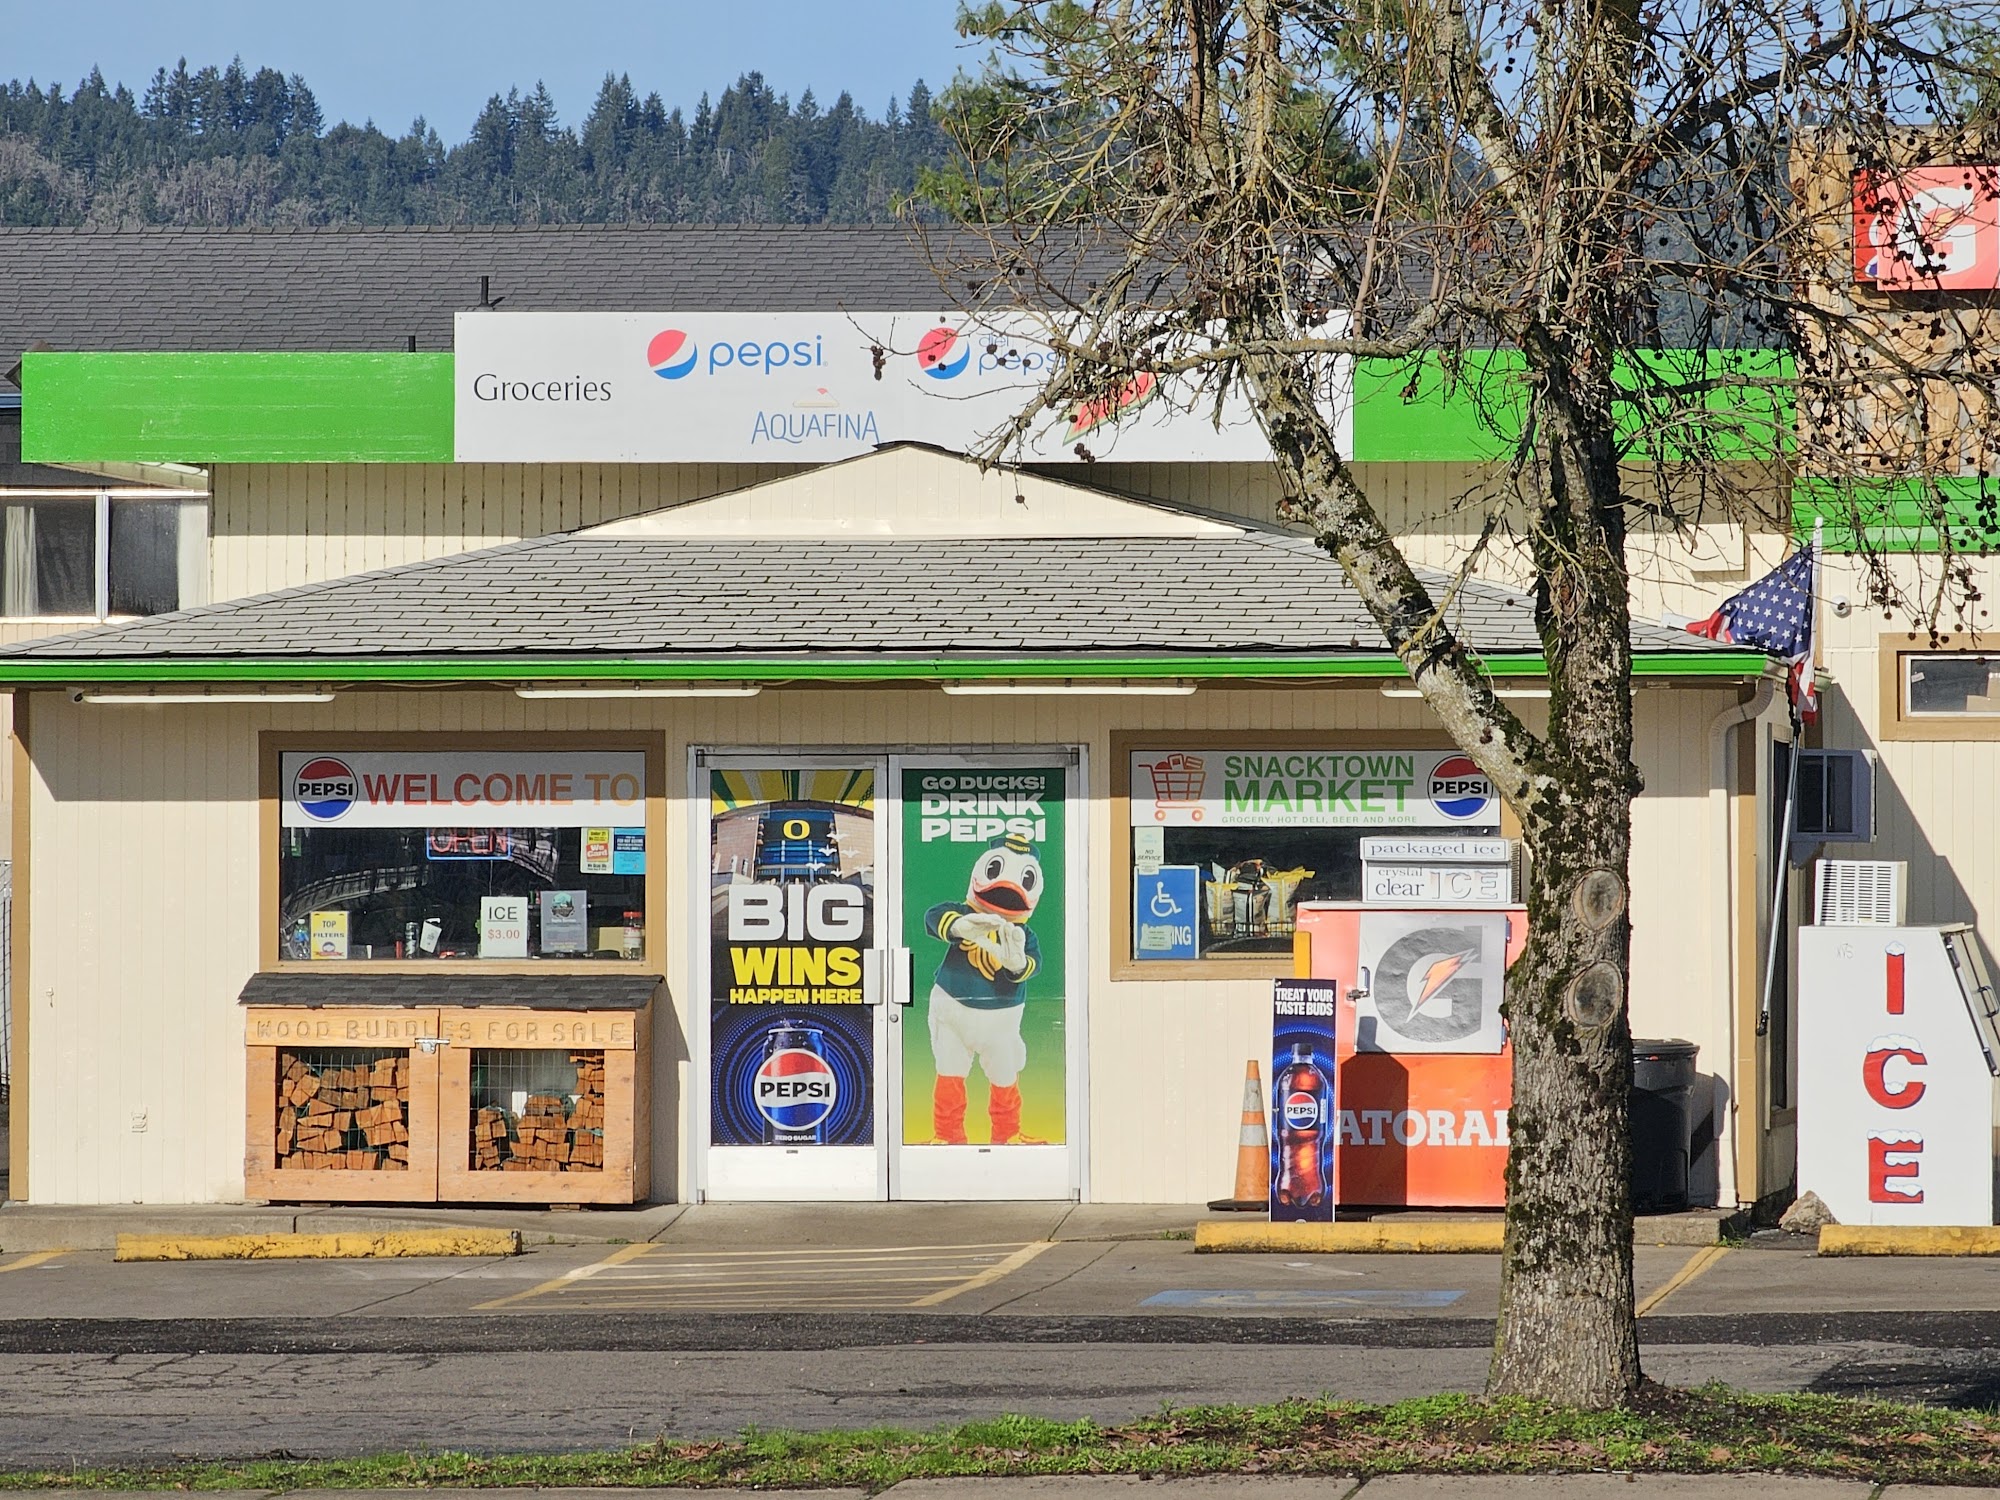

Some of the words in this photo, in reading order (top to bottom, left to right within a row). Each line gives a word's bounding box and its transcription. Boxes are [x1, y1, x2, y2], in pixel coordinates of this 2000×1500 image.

[708, 334, 823, 375] pepsi
[473, 373, 612, 402] Groceries
[751, 410, 881, 444] AQUAFINA
[1224, 755, 1414, 778] SNACKTOWN
[298, 782, 354, 796] PEPSI
[362, 773, 574, 807] WELCOME
[584, 772, 640, 807] TO
[921, 776, 957, 790] GO
[959, 775, 1046, 790] DUCKS!
[1432, 781, 1488, 795] PEPSI
[921, 792, 1046, 816] DRINK
[1224, 779, 1414, 813] MARKET
[1222, 815, 1273, 824] GROCERY,
[1277, 815, 1298, 823] HOT
[1302, 815, 1329, 824] DELI,
[1332, 815, 1359, 823] BEER
[1362, 815, 1384, 823] AND
[1388, 815, 1418, 823] MORE
[783, 819, 810, 840] O
[921, 817, 1046, 842] PEPSI
[1371, 842, 1465, 856] packaged
[1473, 843, 1500, 854] ice
[1378, 866, 1423, 878] crystal
[1375, 878, 1424, 896] clear
[1429, 869, 1499, 900] ICE
[488, 906, 518, 920] ICE
[728, 884, 864, 941] BIG
[322, 920, 337, 928] TOP
[487, 928, 520, 940] $3.00
[730, 946, 862, 986] WINS
[729, 988, 809, 1005] HAPPEN
[811, 988, 863, 1005] HERE
[1275, 987, 1305, 1002] TREAT
[1306, 988, 1334, 1003] YOUR
[1275, 1001, 1307, 1015] TASTE
[1306, 1002, 1334, 1017] BUDS
[256, 1020, 330, 1038] WOOD
[487, 1021, 539, 1041] FOR
[552, 1022, 626, 1042] SALE
[1862, 940, 1928, 1204] ICE
[760, 1082, 830, 1098] PEPSI
[1286, 1106, 1316, 1115] PEPSI
